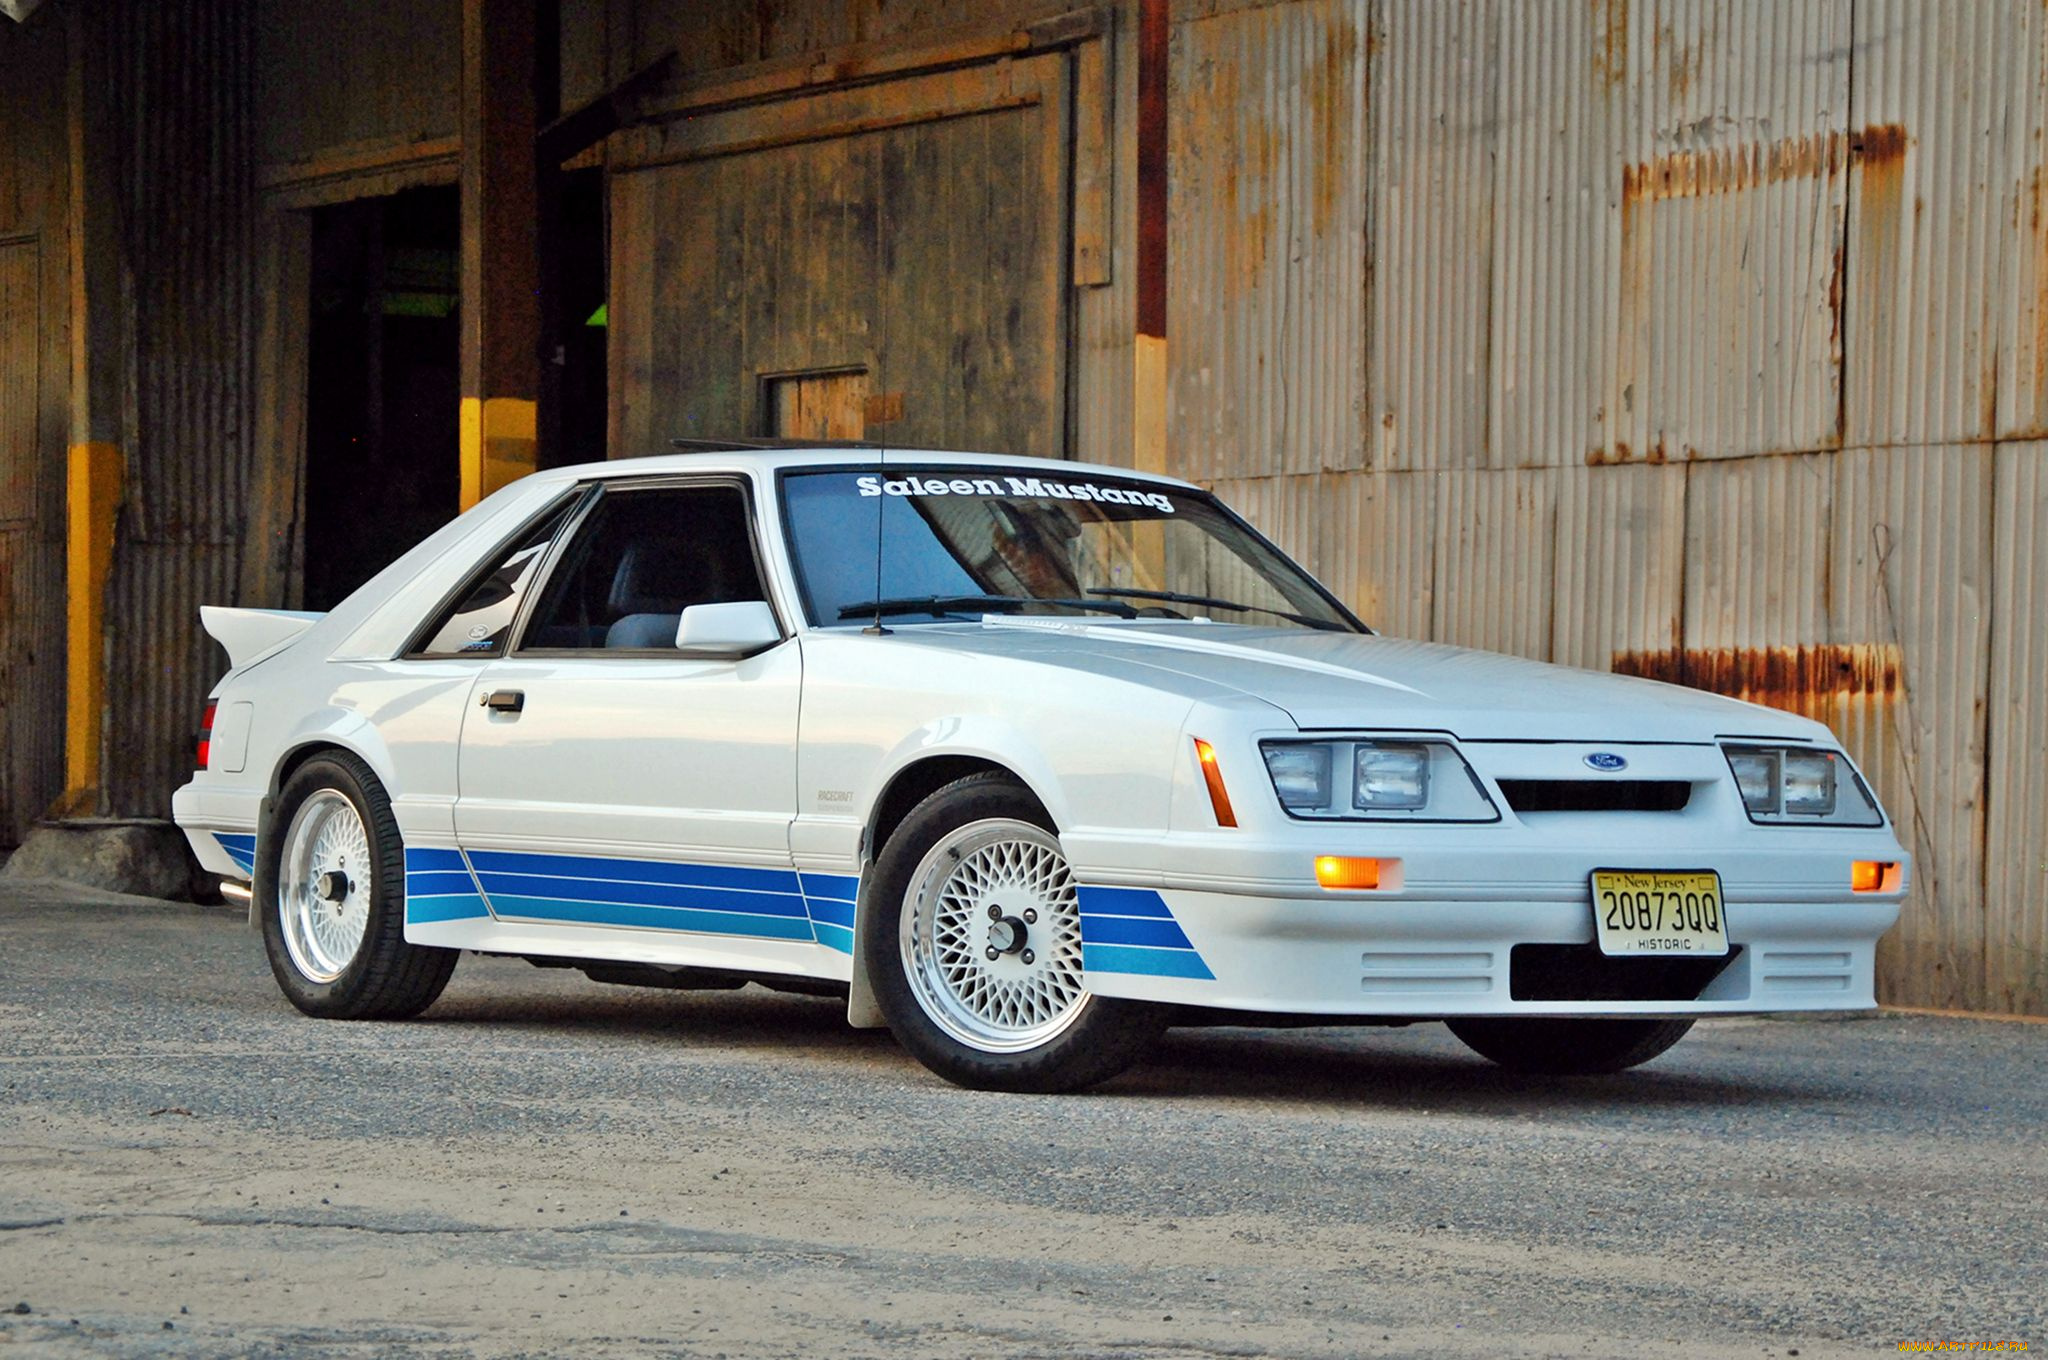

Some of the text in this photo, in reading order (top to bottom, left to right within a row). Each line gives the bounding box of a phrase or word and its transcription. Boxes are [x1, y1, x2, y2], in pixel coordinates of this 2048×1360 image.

[856, 476, 1175, 513] Saleen Mustang
[1624, 875, 1688, 891] New Jersey
[1602, 891, 1720, 933] 20873QQ
[1638, 938, 1692, 950] HISTORIC
